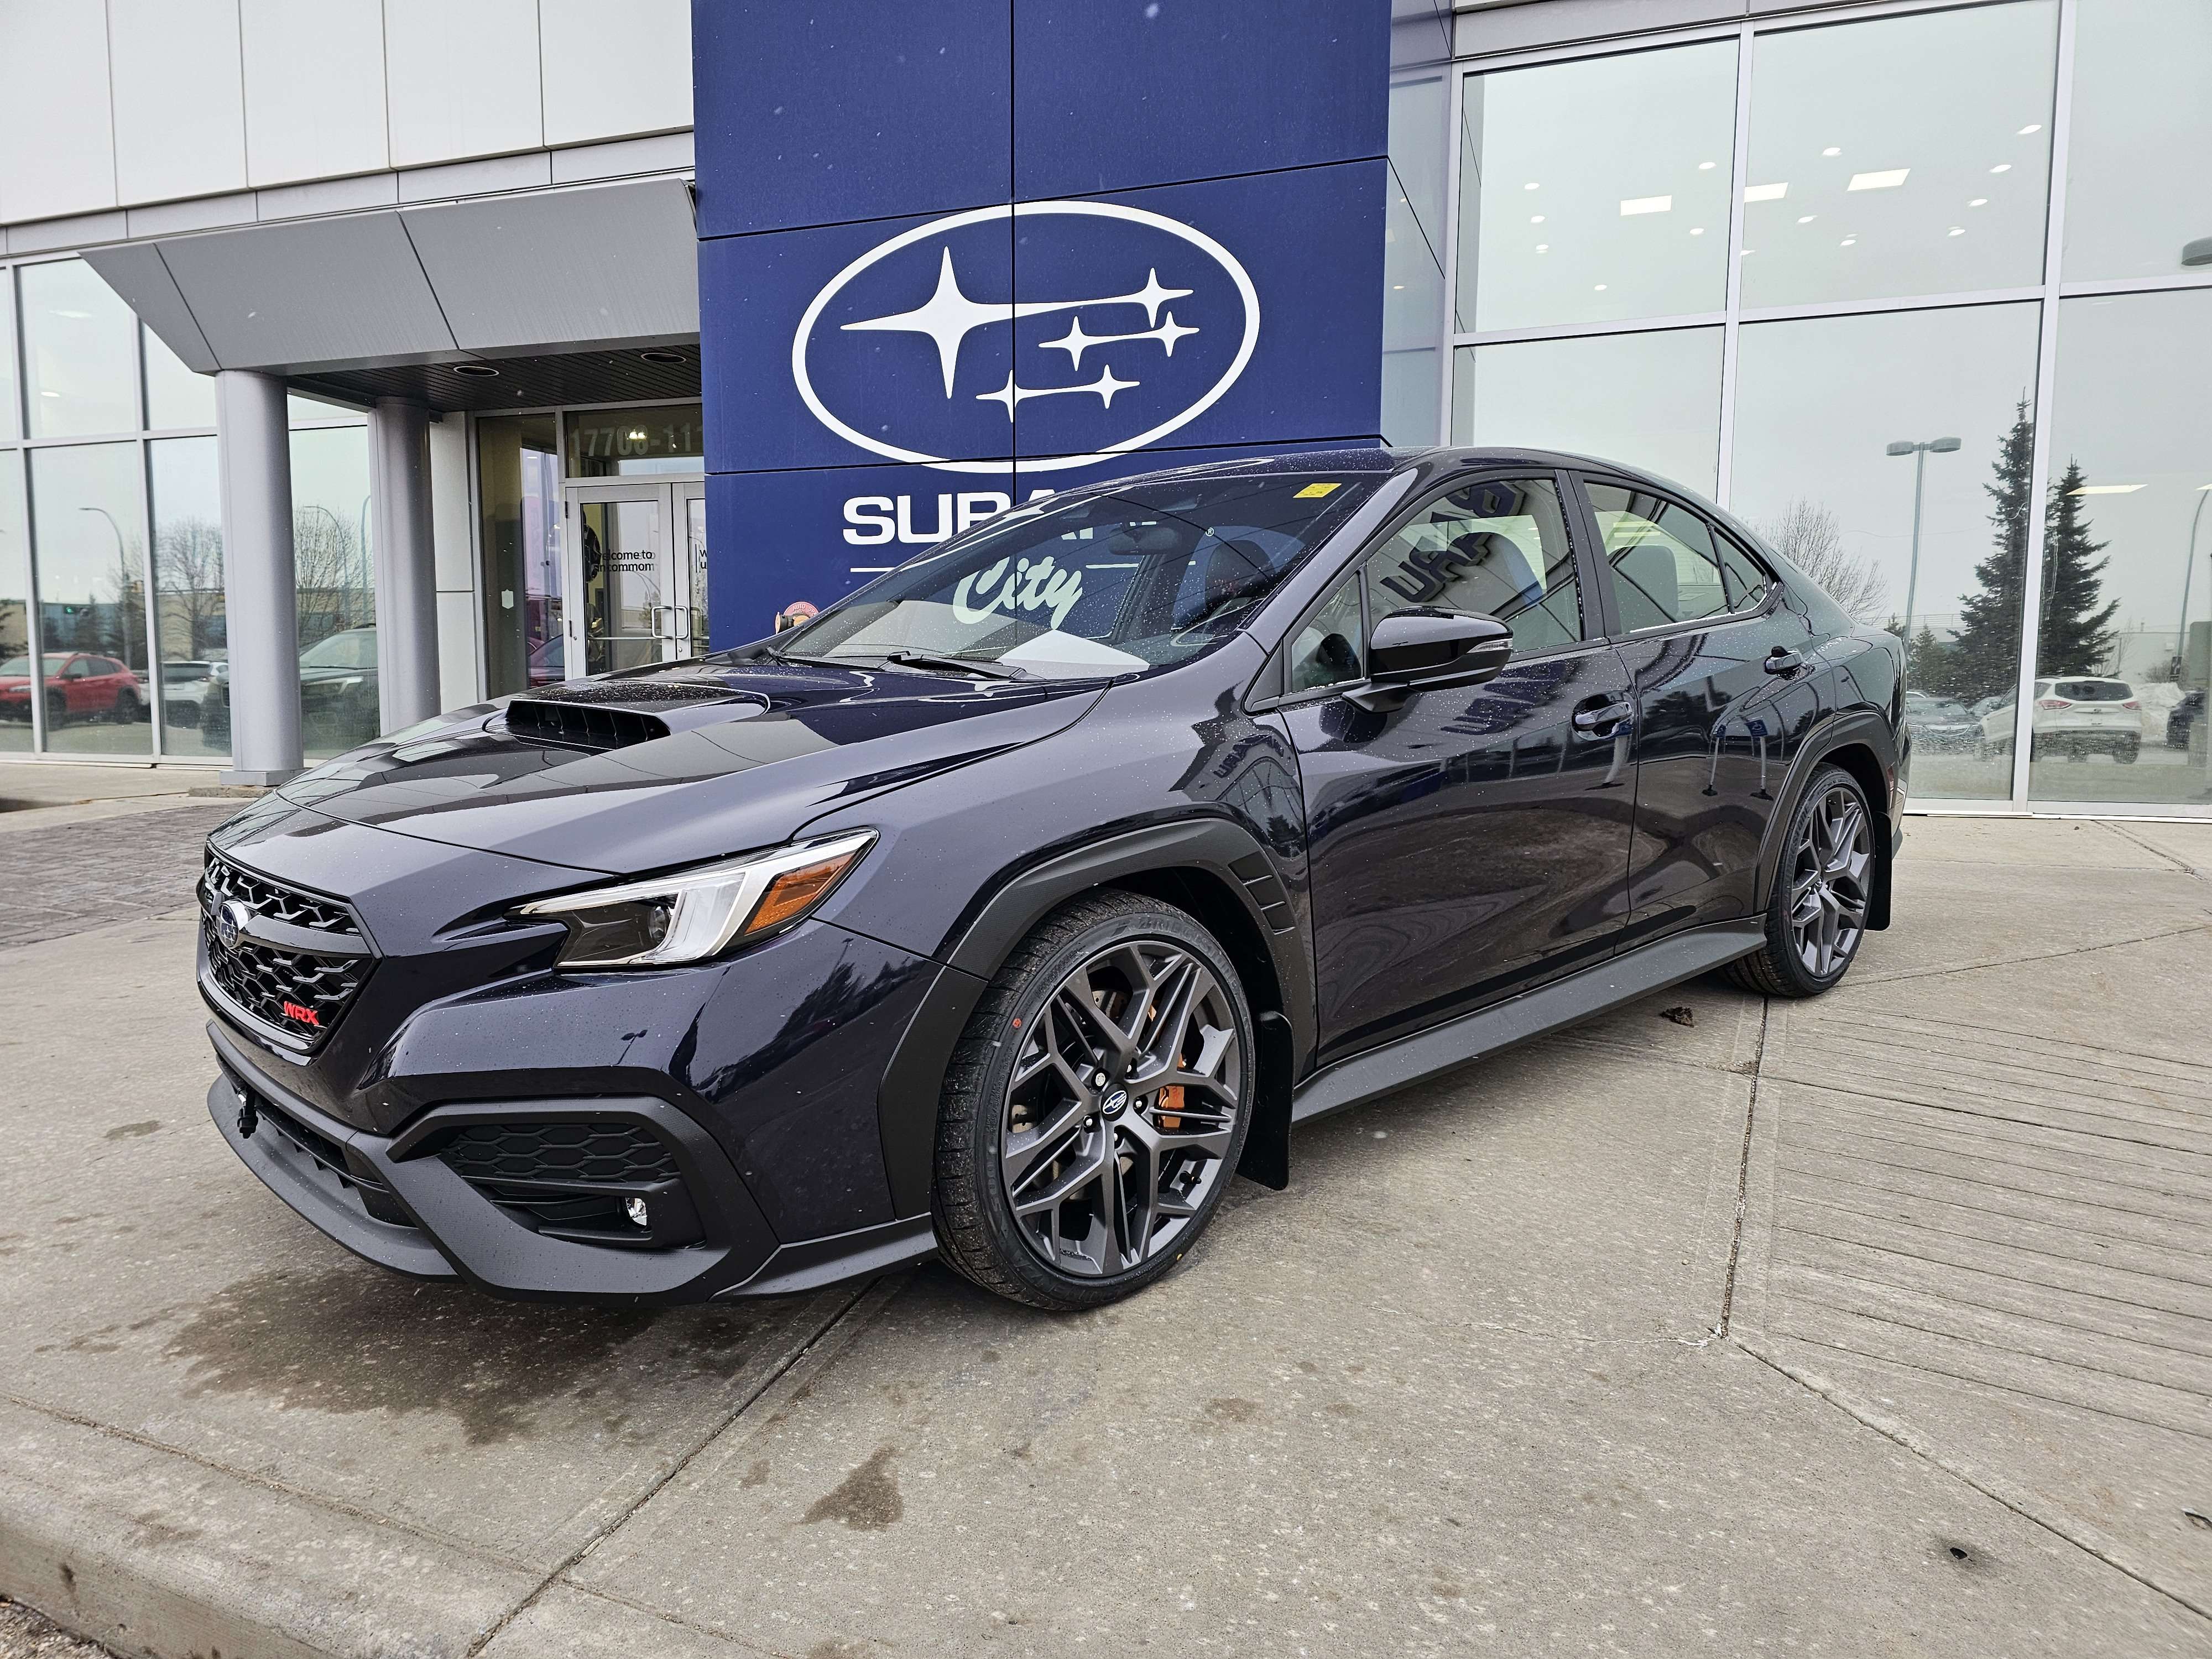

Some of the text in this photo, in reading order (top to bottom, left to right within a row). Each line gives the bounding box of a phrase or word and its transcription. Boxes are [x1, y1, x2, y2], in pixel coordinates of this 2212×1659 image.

[843, 489, 1057, 545] SUB
[602, 549, 653, 560] elcome to
[953, 556, 1083, 629] City
[284, 1000, 319, 1025] WRX
